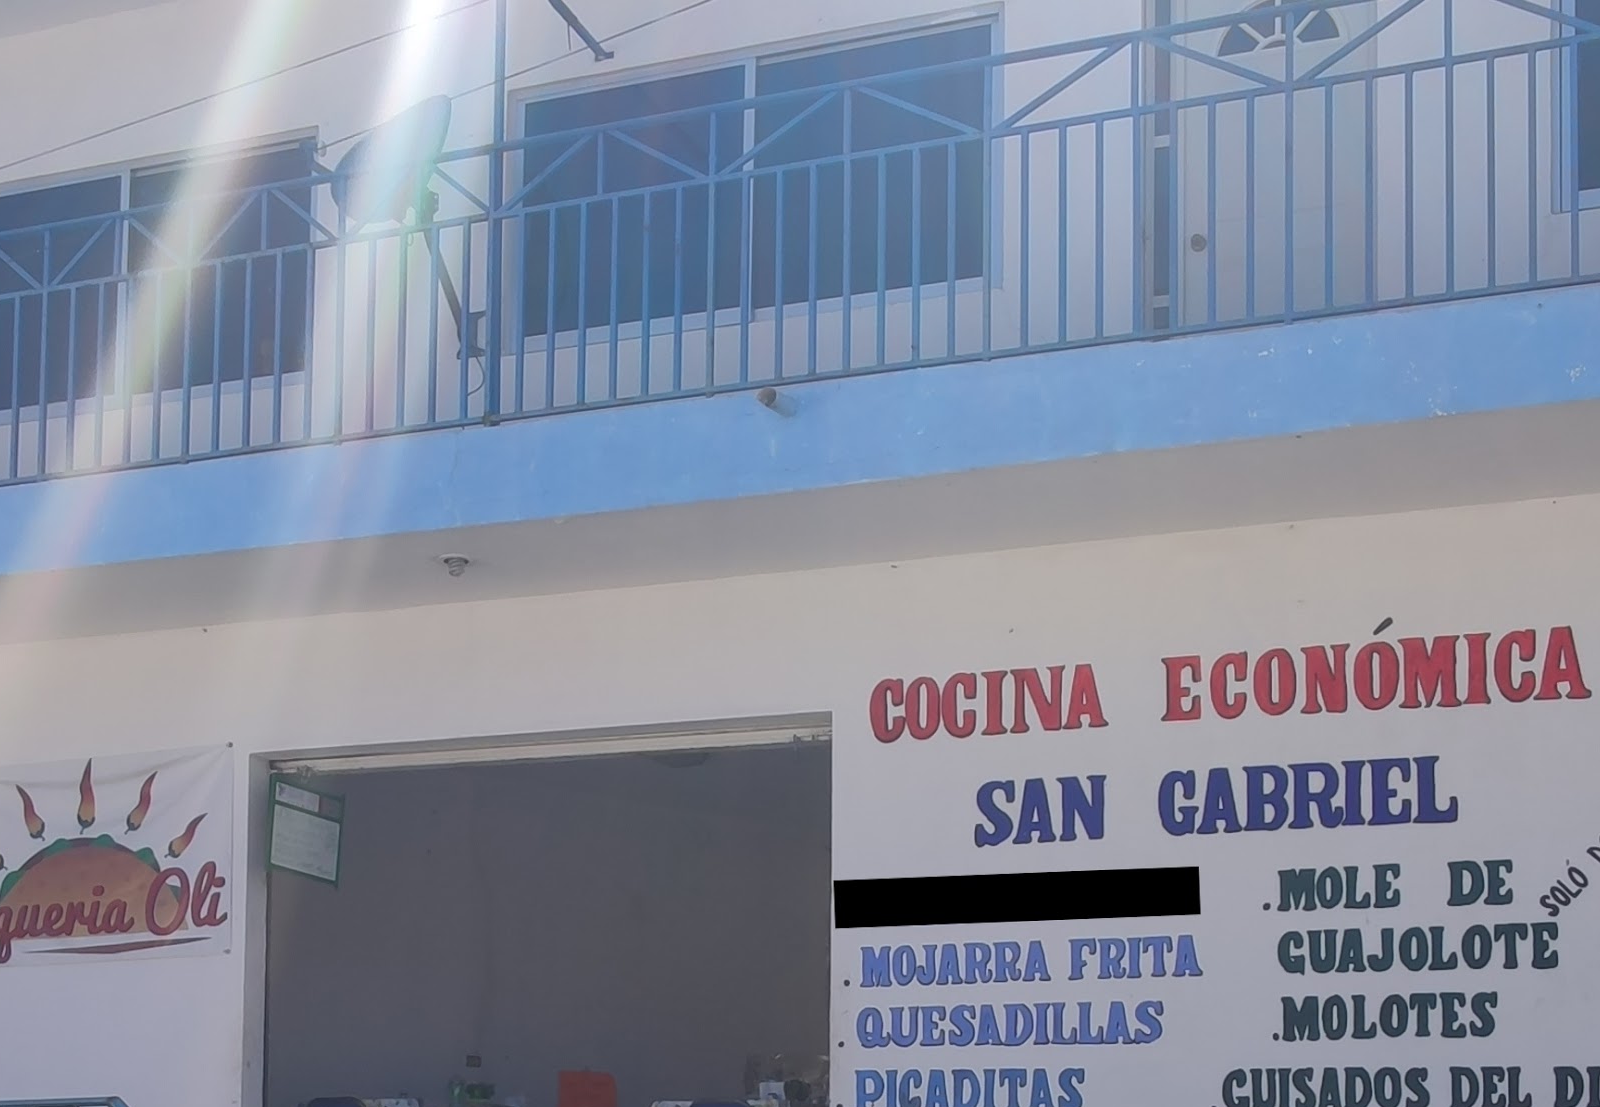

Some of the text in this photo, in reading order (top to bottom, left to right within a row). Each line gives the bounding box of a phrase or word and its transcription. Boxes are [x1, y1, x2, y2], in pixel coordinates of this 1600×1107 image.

[869, 617, 1593, 743] COCINA ECONÓMICA
[974, 755, 1459, 848] SAN GABRIEL
[145, 861, 229, 937] Oli
[1447, 859, 1514, 907] DE
[859, 934, 1203, 988] MOJARRA FRITA
[1277, 921, 1559, 976] GUAJOLOTE
[855, 1000, 1164, 1049] QUESADILLAS
